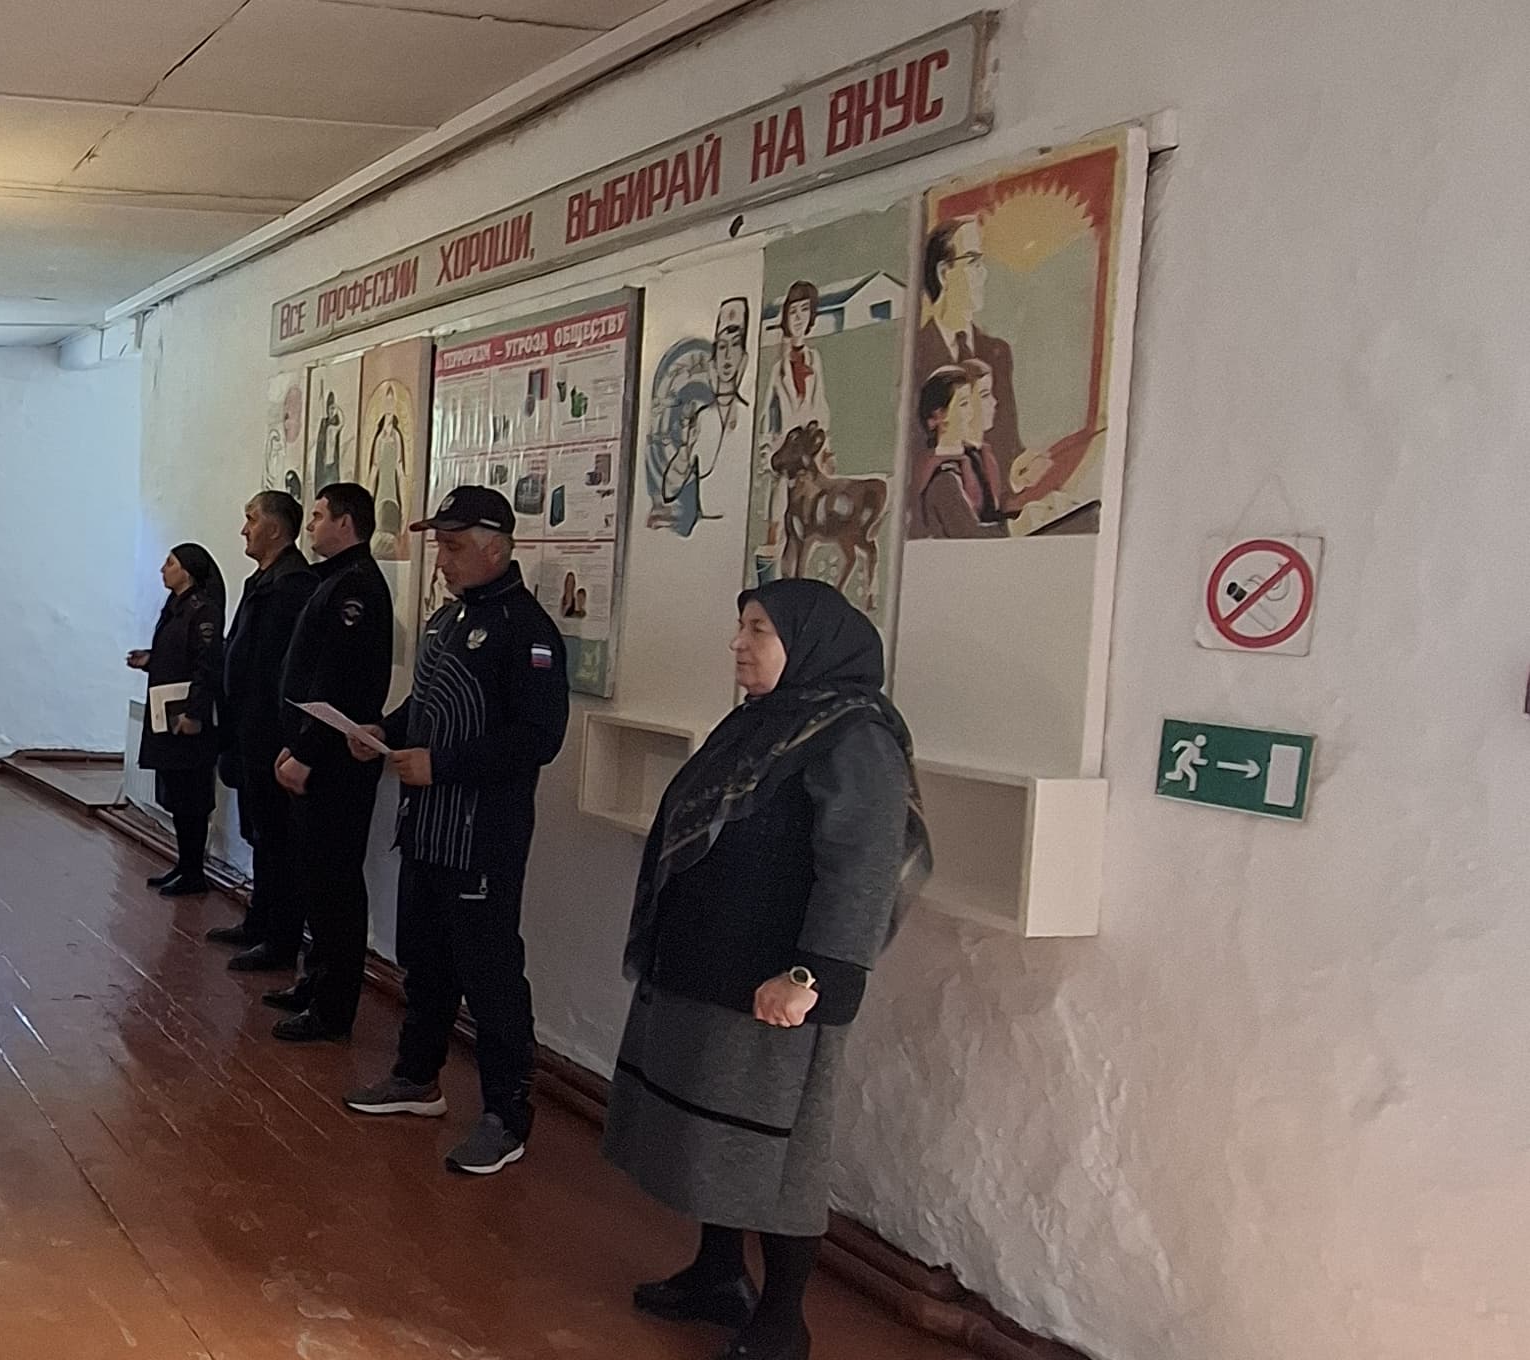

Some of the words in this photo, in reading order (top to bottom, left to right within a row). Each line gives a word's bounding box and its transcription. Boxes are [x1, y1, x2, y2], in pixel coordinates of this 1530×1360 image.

[280, 300, 307, 341] ВСЕ
[316, 255, 419, 329] ПРОФЕССИИ
[436, 211, 536, 288] ХОРОШИ,
[564, 133, 723, 246] ВЫБИРАЙ
[750, 105, 806, 184] НА
[824, 47, 950, 158] ВКУС
[504, 330, 549, 359] УГРОЗА
[553, 310, 628, 349] ОБЩЕСТВУ
